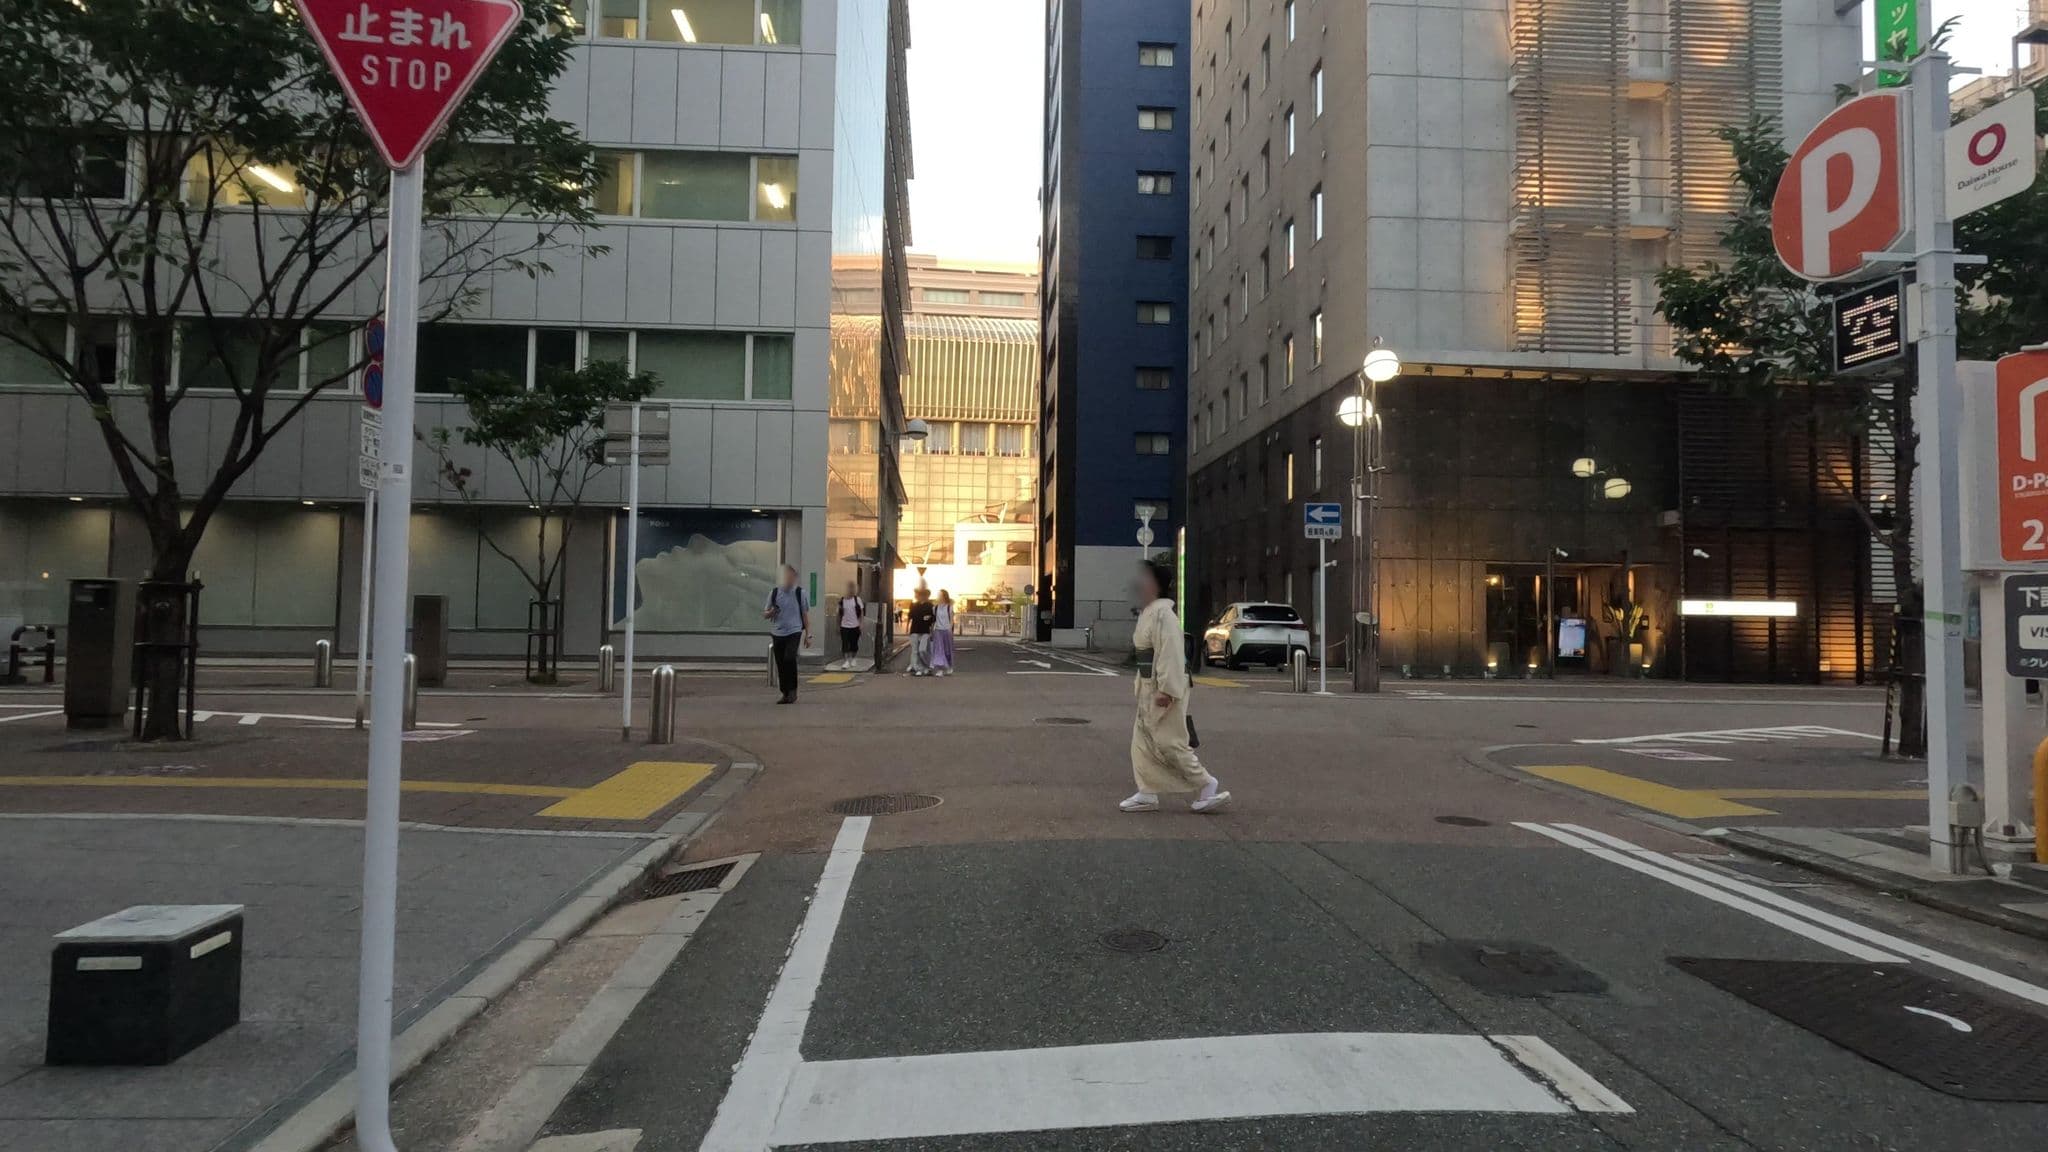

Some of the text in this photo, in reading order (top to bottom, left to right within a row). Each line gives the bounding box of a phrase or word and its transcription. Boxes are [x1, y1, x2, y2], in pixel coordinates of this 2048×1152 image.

[338, 3, 472, 50] 止まれ
[361, 54, 452, 92] STOP
[1957, 158, 2019, 190] Daiwa House
[1801, 127, 1882, 276] P
[1842, 294, 1899, 364] 空
[2022, 519, 2048, 551] 2
